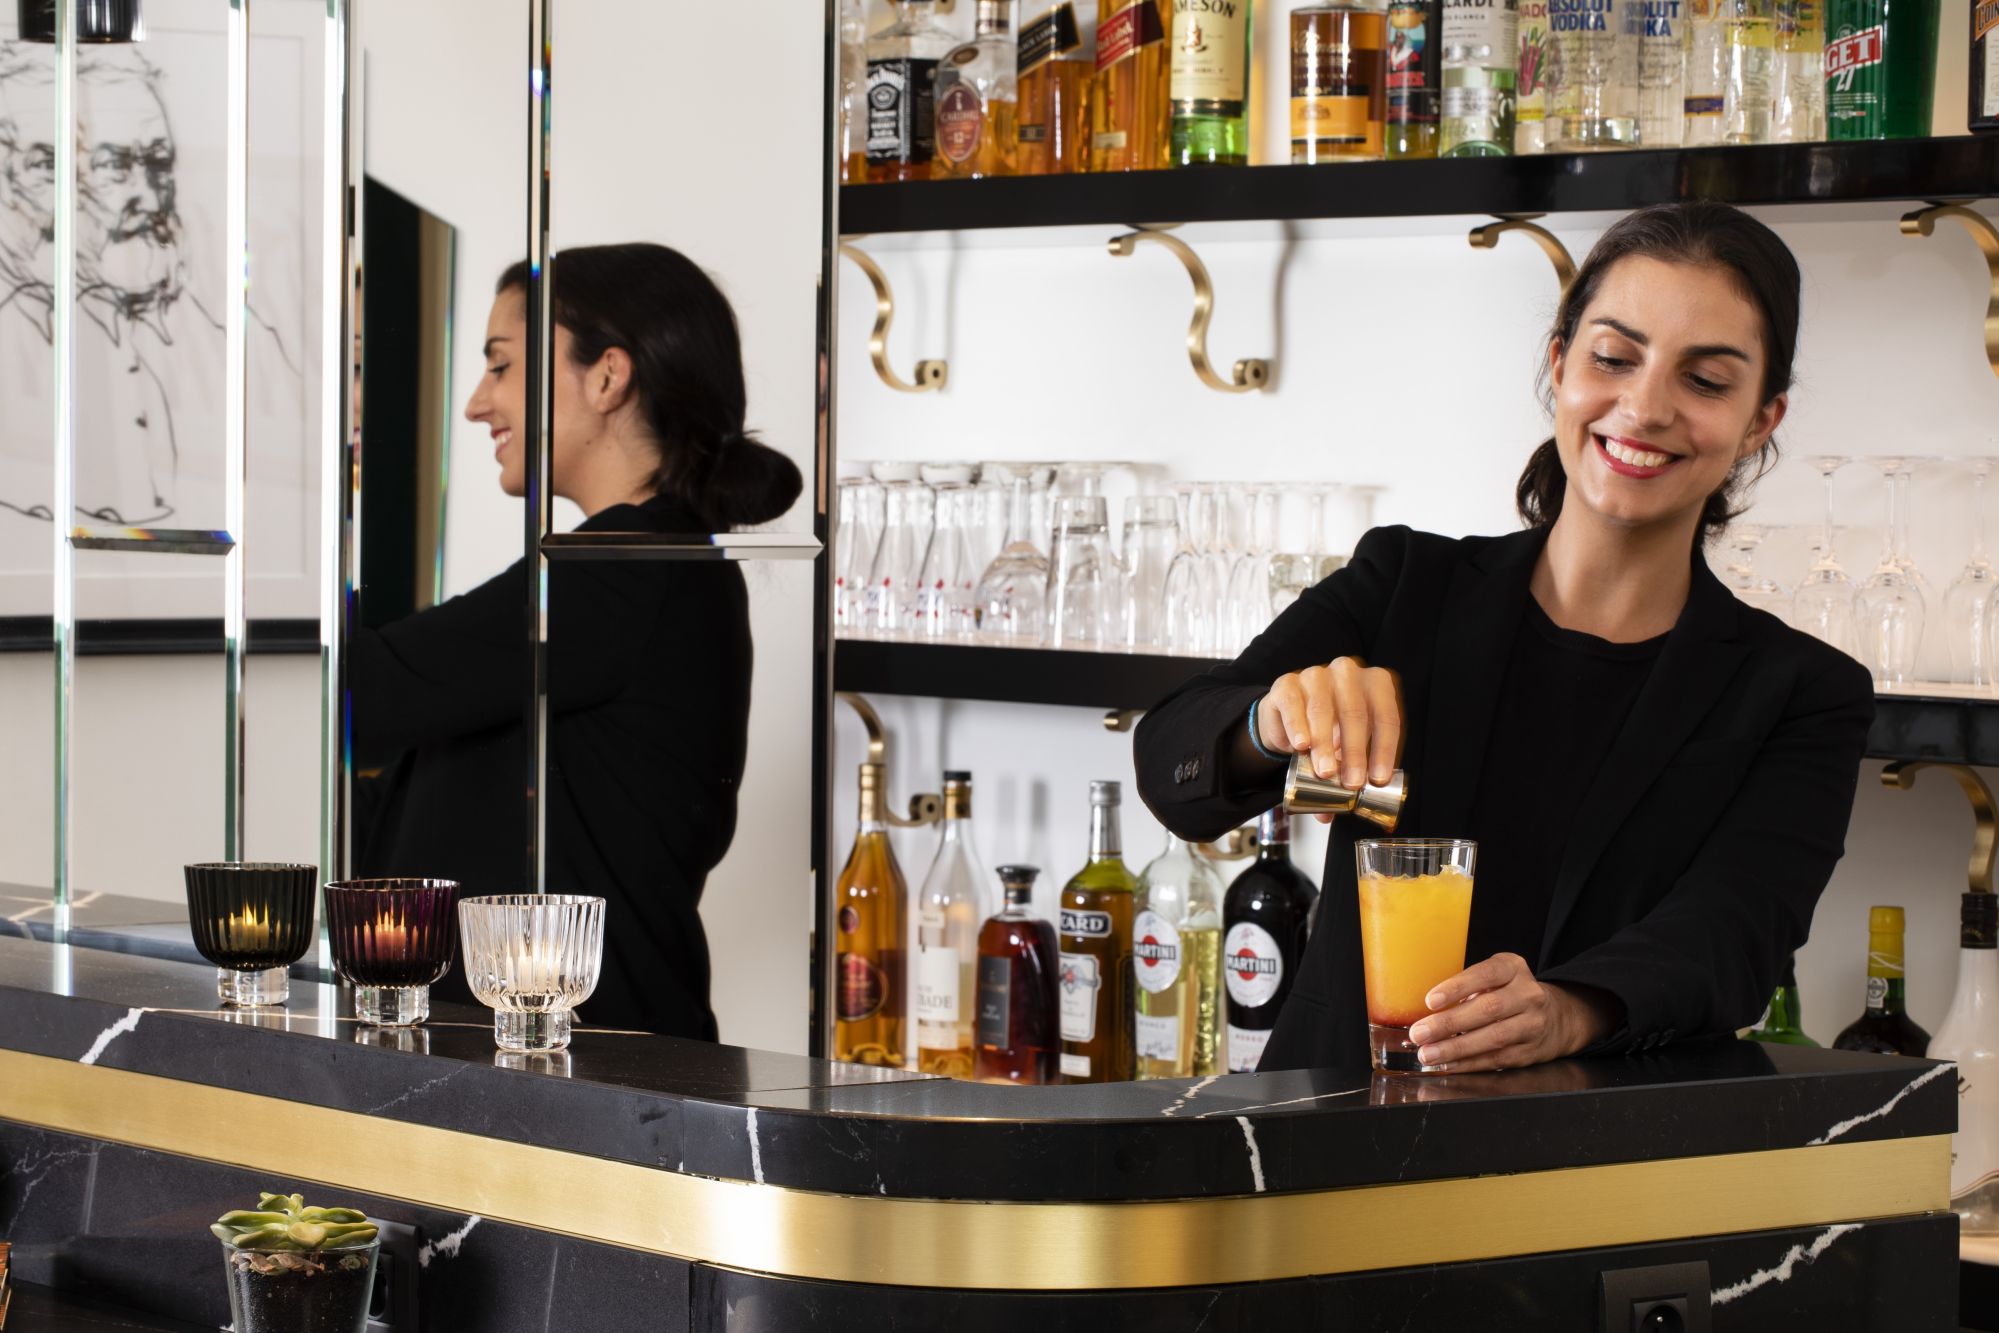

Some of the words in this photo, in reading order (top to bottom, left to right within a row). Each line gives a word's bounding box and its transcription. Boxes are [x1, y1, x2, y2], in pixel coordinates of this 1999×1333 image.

[1551, 14, 1607, 31] VODKA
[1825, 33, 1876, 73] GET
[1836, 64, 1856, 91] 27
[1135, 942, 1177, 961] MARTINI
[1227, 953, 1277, 974] MARTINI
